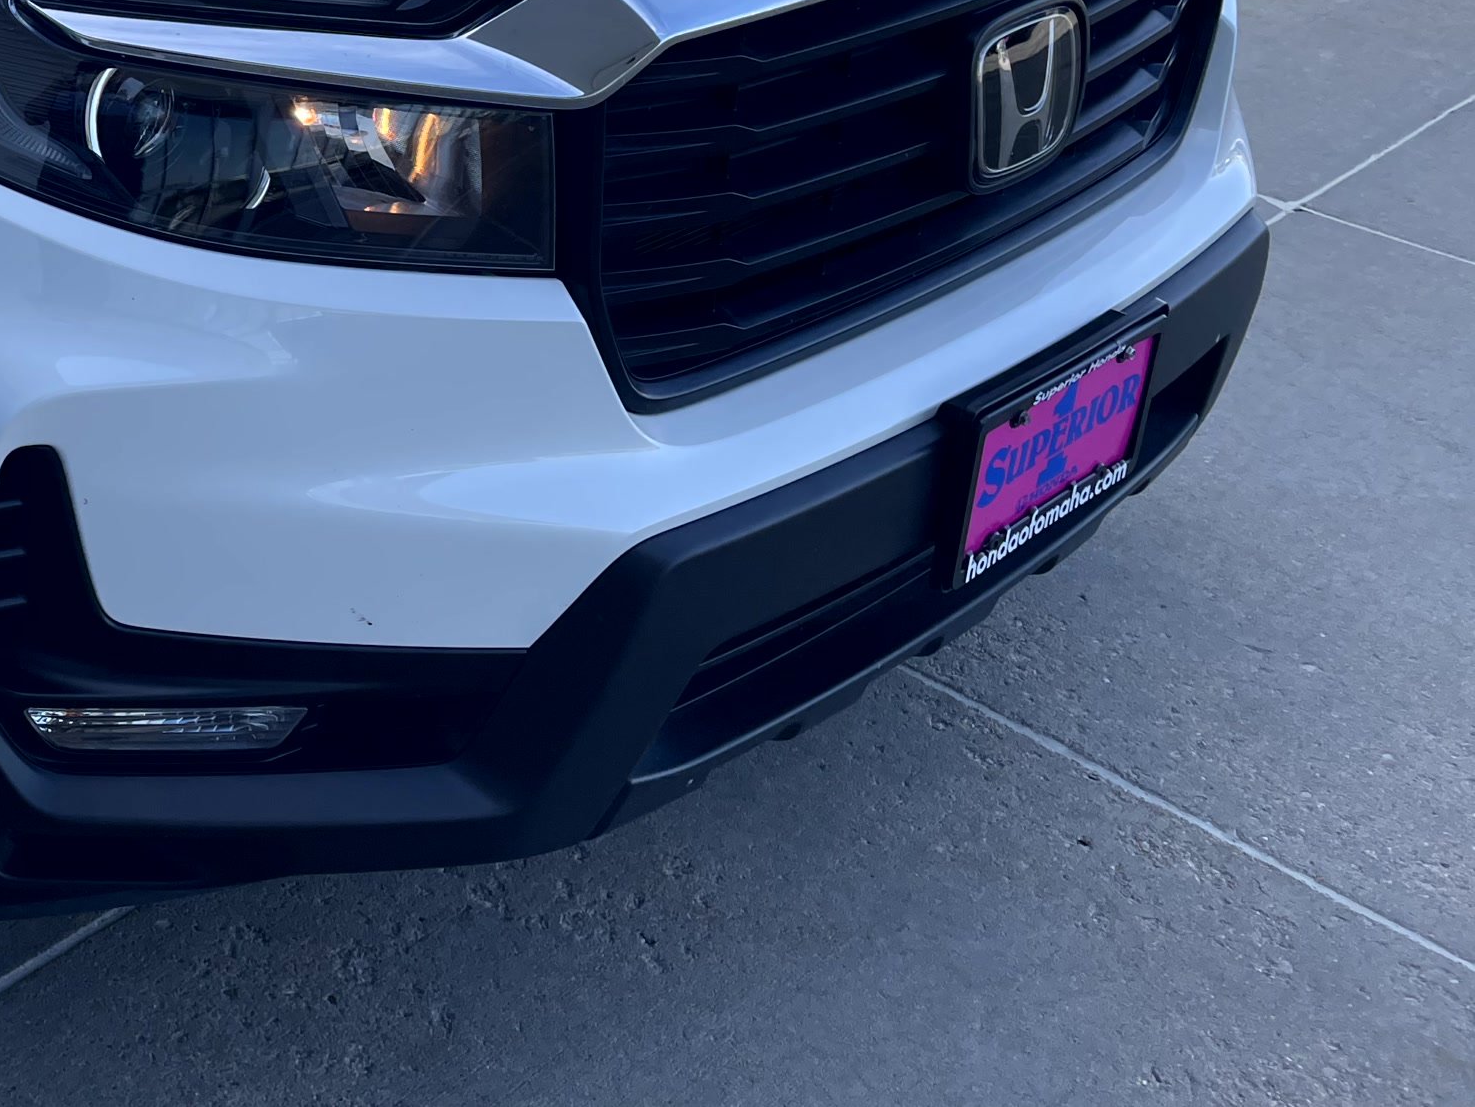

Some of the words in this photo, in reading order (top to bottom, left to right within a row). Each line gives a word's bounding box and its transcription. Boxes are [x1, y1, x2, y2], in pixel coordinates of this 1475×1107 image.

[976, 373, 1141, 508] SUPERIOR
[1033, 368, 1087, 405] Superior
[965, 462, 1128, 583] hondaofomaha.com
